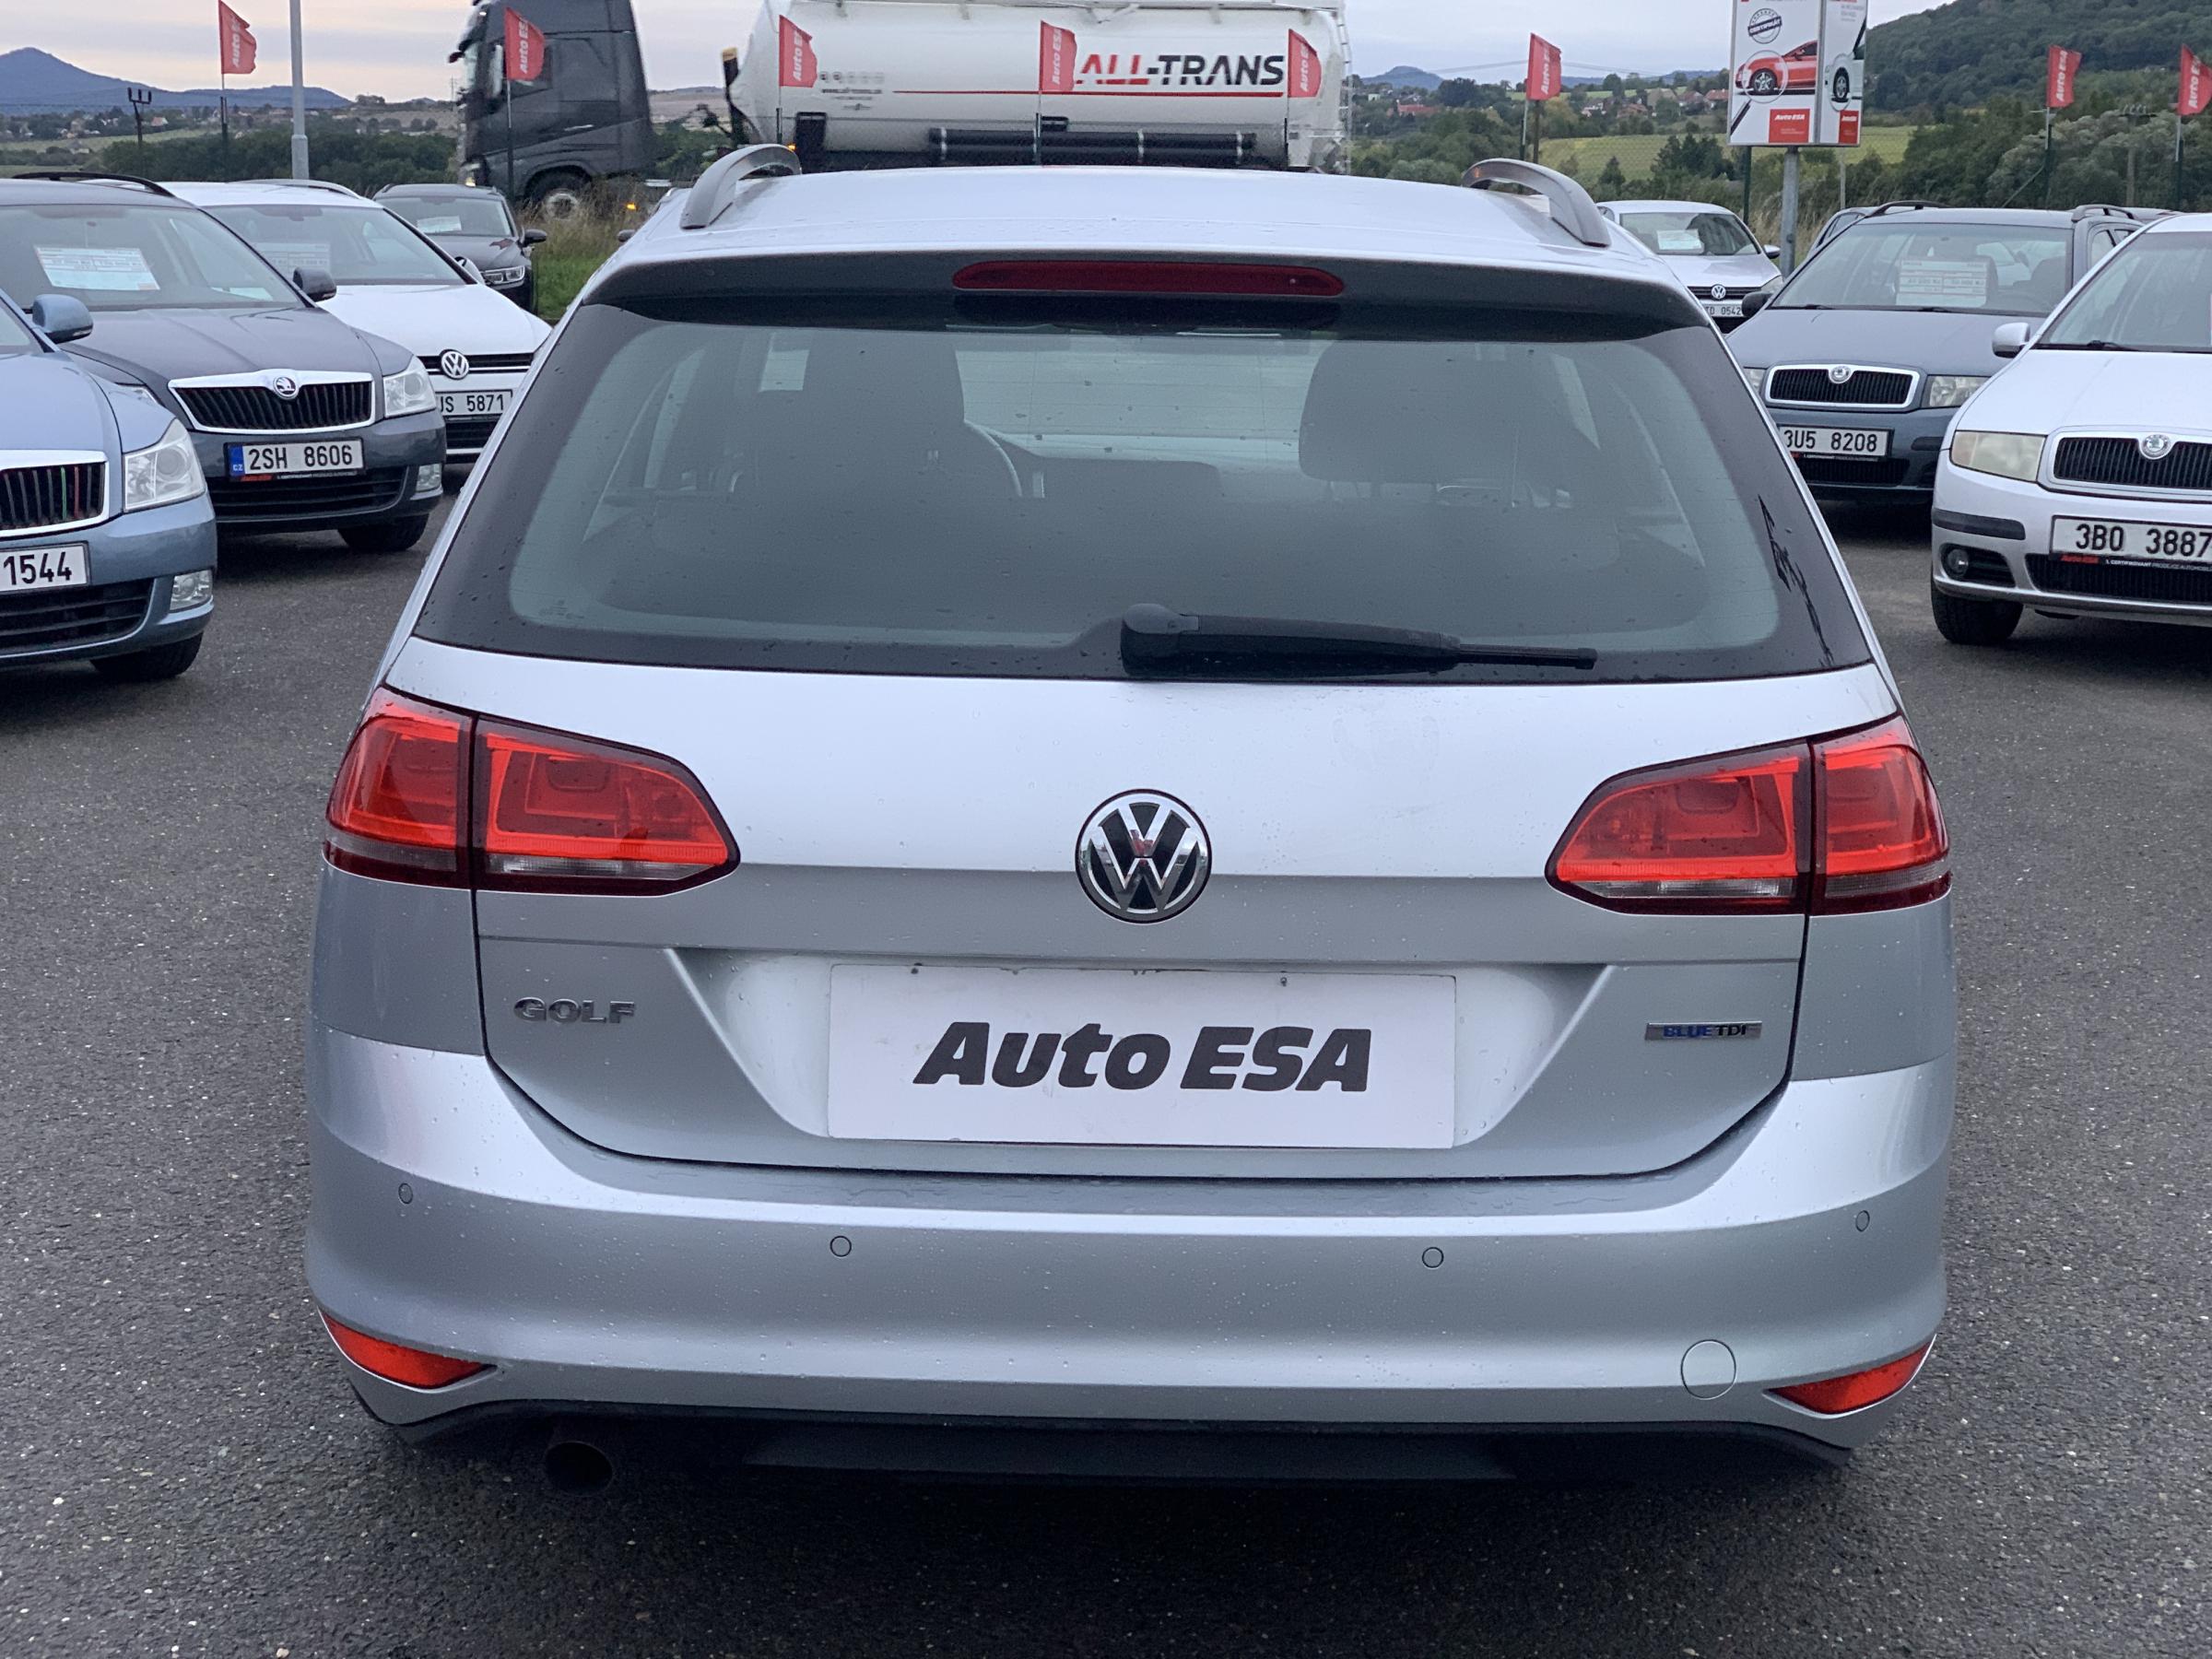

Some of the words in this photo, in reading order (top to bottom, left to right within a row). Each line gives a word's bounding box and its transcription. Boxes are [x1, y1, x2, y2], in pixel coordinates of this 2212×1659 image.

[231, 33, 241, 68] Auto
[519, 40, 528, 74] Auto
[793, 47, 802, 81] Auto
[1052, 52, 1061, 85] Auto
[1077, 53, 1284, 86] ALL-TRANS
[1300, 59, 1309, 92] Auto
[1540, 63, 1549, 95] Auto
[2055, 72, 2065, 102] Auto
[2188, 76, 2198, 109] Auto
[466, 394, 504, 412] 5871
[1783, 429, 1817, 449] 3U5
[1830, 431, 1877, 453] 8208
[248, 447, 288, 471] 2SH
[304, 445, 353, 467] 8606
[2076, 524, 2124, 552] 3B0
[2146, 527, 2212, 559] 3887
[4, 551, 72, 585] 1544
[514, 996, 635, 1024] GOLF
[912, 1021, 1171, 1090] Auto
[1180, 1026, 1371, 1092] ESA
